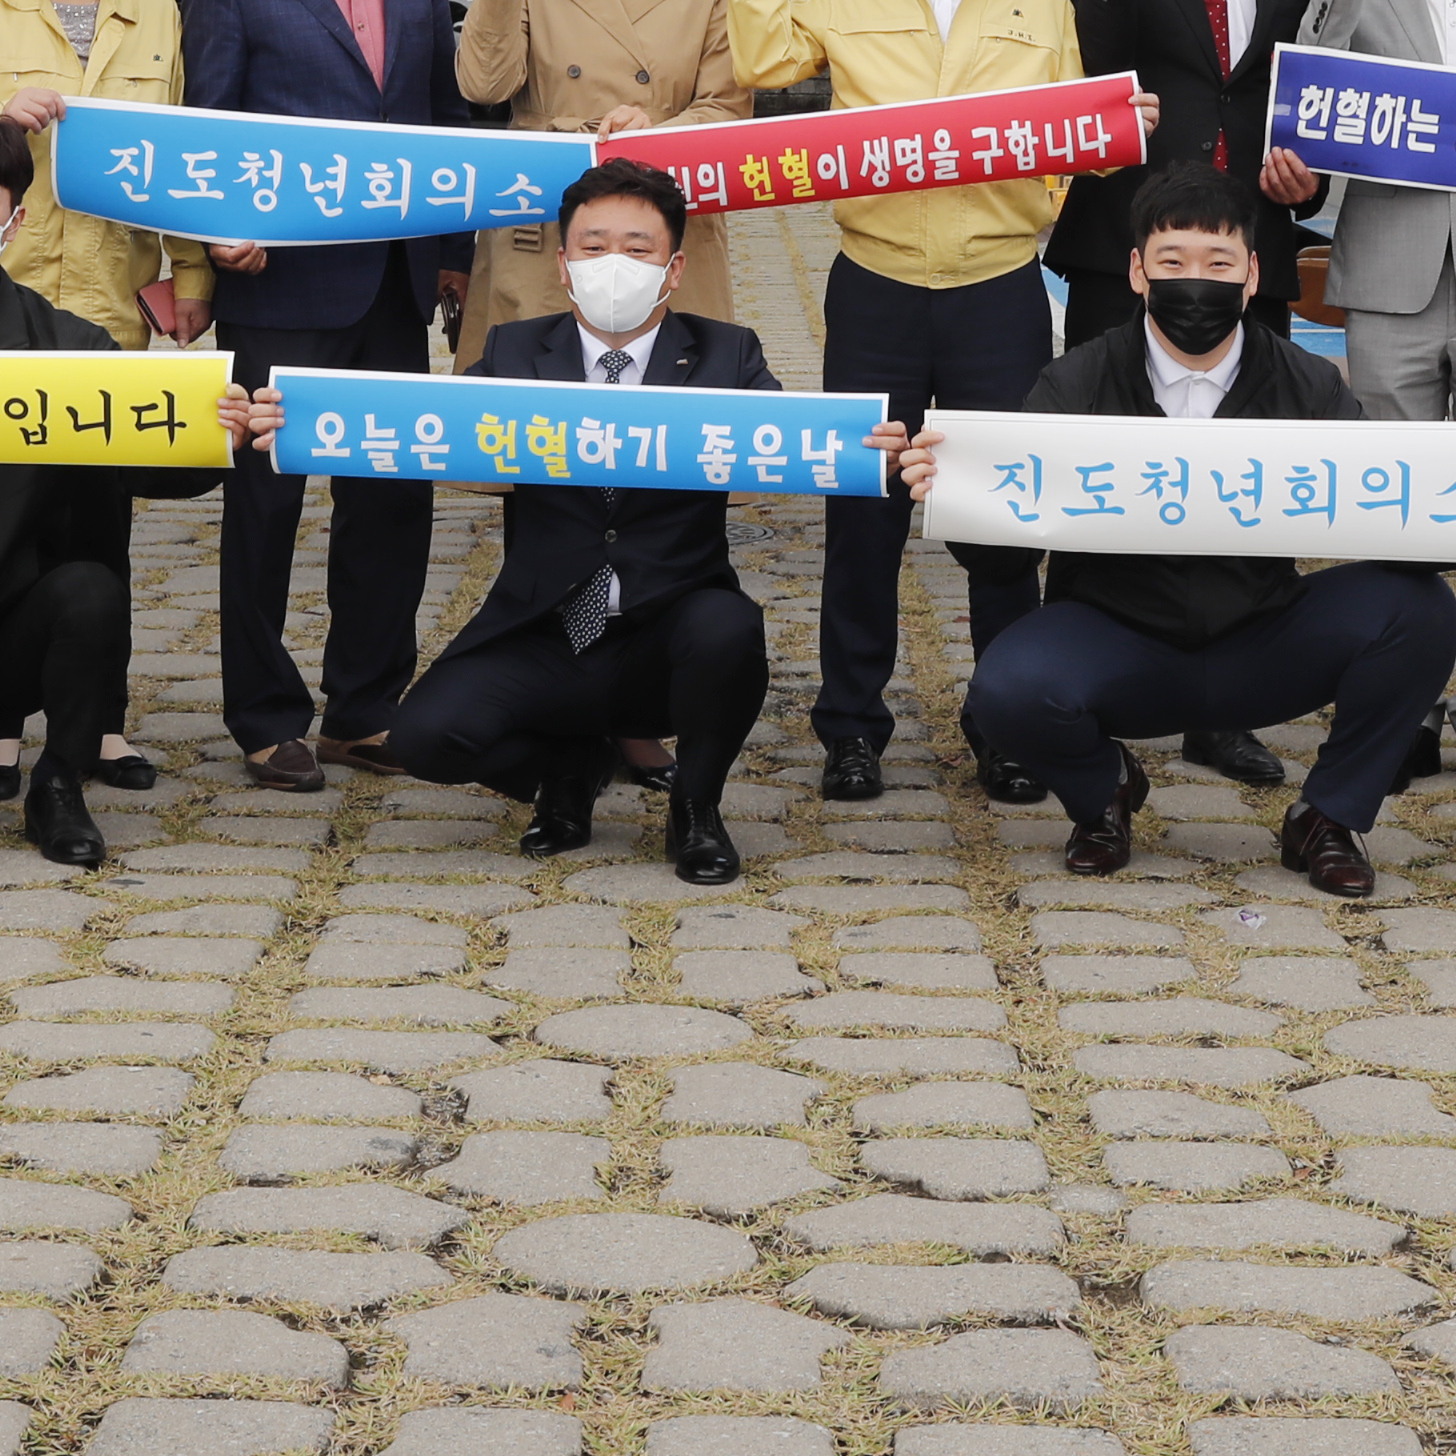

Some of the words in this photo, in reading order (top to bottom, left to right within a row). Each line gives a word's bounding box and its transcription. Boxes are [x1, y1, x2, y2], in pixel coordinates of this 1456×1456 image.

[1295, 84, 1440, 153] 헌혈하는
[104, 139, 546, 222] 진도청년회의소
[738, 144, 850, 201] 헌혈이
[859, 128, 959, 189] 생명을
[971, 113, 1113, 175] 구합니다
[310, 411, 451, 473] 오늘은
[474, 412, 669, 479] 헌혈하기
